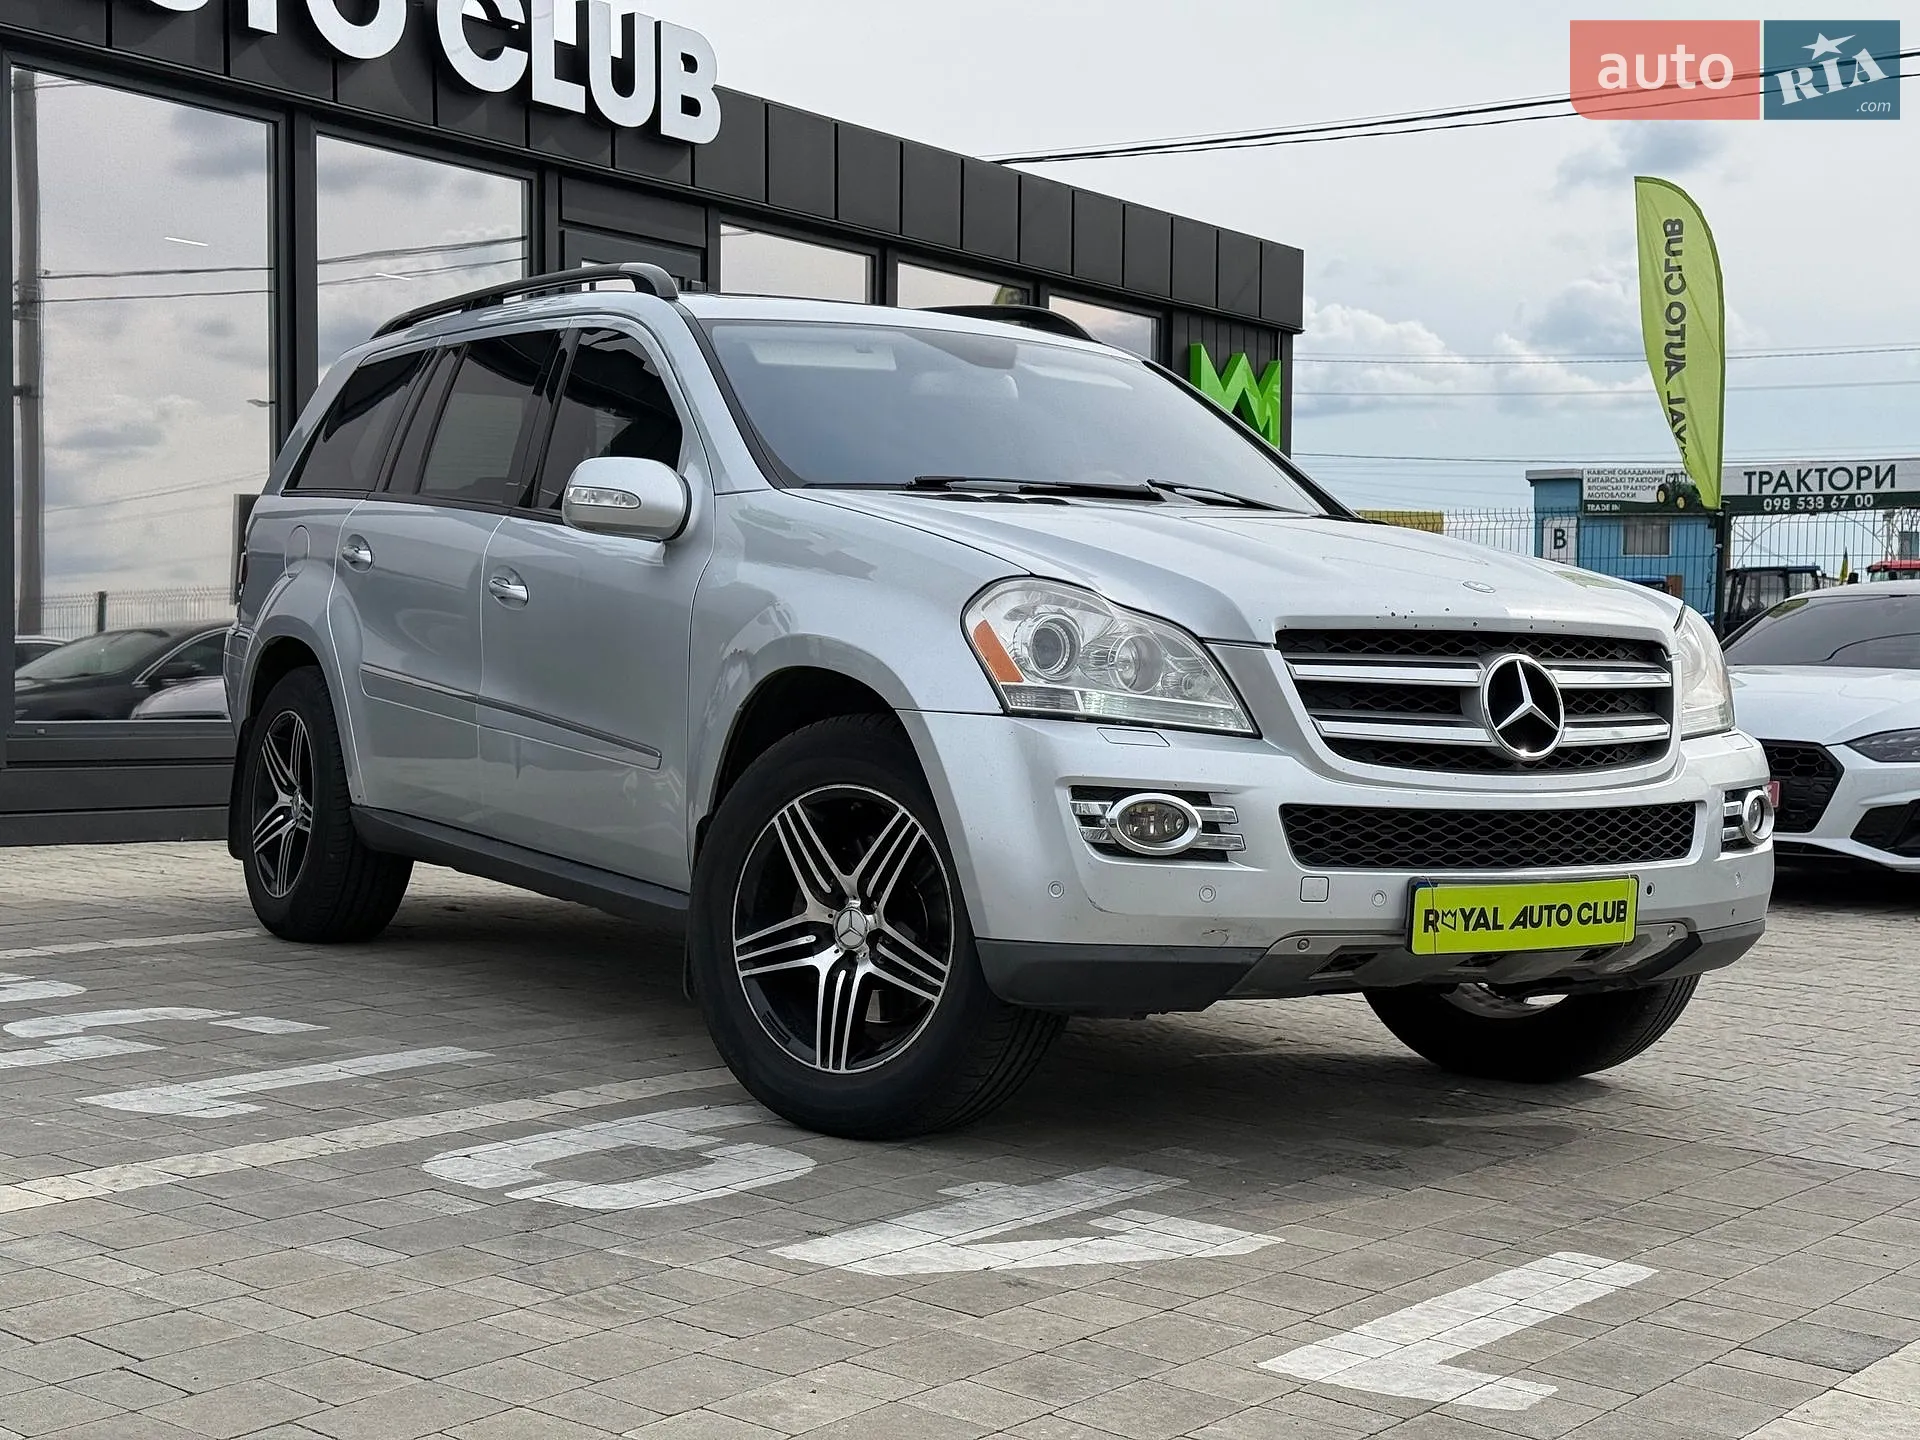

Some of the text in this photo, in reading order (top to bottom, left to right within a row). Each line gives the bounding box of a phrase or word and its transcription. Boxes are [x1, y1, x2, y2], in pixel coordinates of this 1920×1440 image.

[1743, 464, 1896, 495] ТРАКТОРИ
[1763, 498, 1791, 511] 098
[1830, 495, 1849, 508] 67
[1855, 494, 1874, 507] 00
[1509, 903, 1574, 931] AUTO
[1577, 900, 1628, 926] CLUB
